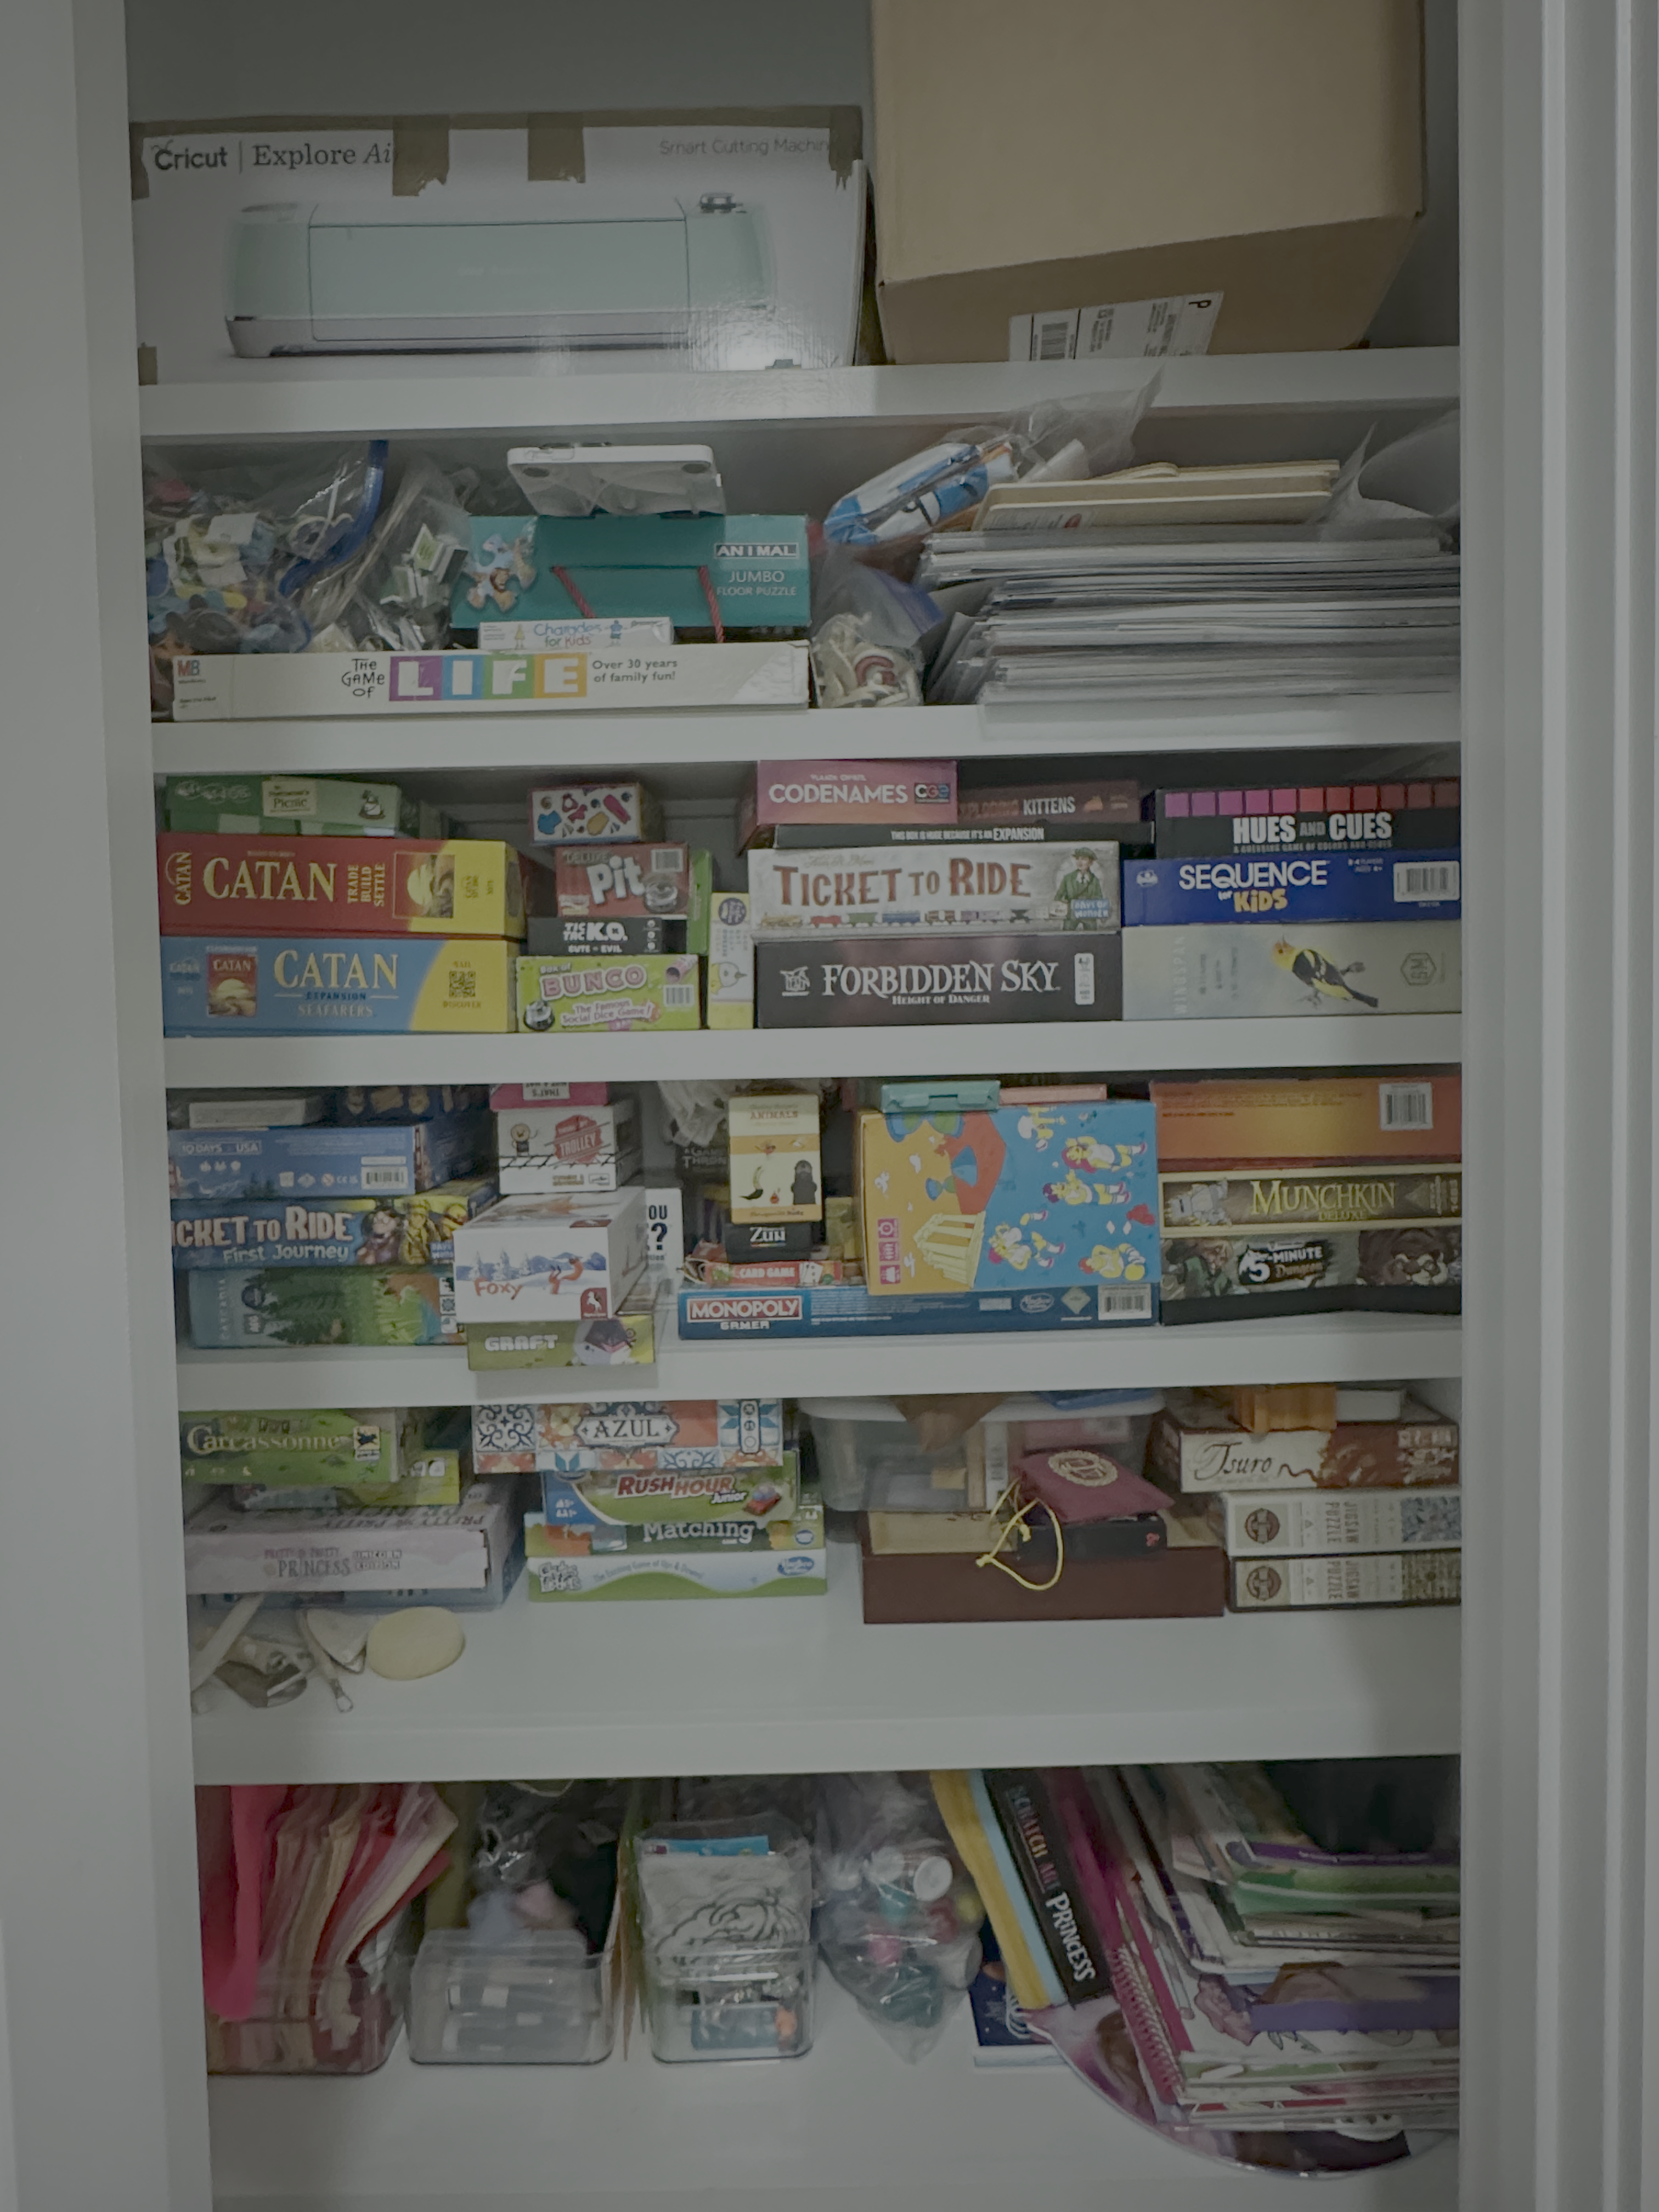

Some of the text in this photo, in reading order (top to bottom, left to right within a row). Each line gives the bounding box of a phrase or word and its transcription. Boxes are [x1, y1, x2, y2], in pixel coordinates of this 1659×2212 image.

[152, 139, 391, 170] Cricut Explore Ai
[660, 138, 830, 156] Smart Cutting Machin
[716, 545, 797, 556] ANIMAL
[729, 571, 785, 583] JUMBO
[716, 586, 797, 596] FLOOR PUZZLE
[534, 621, 601, 636] Charades
[545, 635, 592, 648] for Kids
[177, 659, 200, 676] MB
[592, 659, 678, 671] Over 30 years
[398, 658, 580, 697] LIFE
[594, 671, 675, 684] of family fun!
[769, 783, 909, 804] CODENAMES
[1023, 795, 1076, 816] KITTENS
[891, 830, 905, 840] THIS
[993, 827, 1044, 840] EXPANSION
[1233, 811, 1392, 844] HUES AND CUES
[174, 851, 192, 905] CATAN
[204, 856, 338, 902] CATAN
[347, 864, 359, 904] TRADE
[360, 865, 373, 903] BUILD
[374, 861, 386, 908] SETTLE
[772, 856, 1032, 906] TICKET TO RIDE
[1178, 860, 1328, 890] SEQUENCE
[1217, 890, 1233, 901] for
[563, 932, 585, 941] TAC
[565, 922, 585, 932] TIC
[586, 922, 629, 941] K.O.
[568, 944, 623, 953] CUTE EVIL
[212, 960, 252, 972] CATAN
[273, 949, 399, 990] CATAN
[1172, 936, 1186, 1015] WINGSPAN
[541, 964, 646, 1000] BUNCO
[821, 959, 1059, 998] FORBIDDEN SKY
[304, 991, 367, 1001] EXPANSION
[891, 994, 990, 1005] HEIGHT OF DANGER
[298, 1003, 374, 1018] SEAFARERS
[575, 1000, 636, 1015] The Famous
[562, 1012, 591, 1024] Social
[594, 1011, 614, 1020] Dice
[532, 1088, 560, 1097] THAT'S
[750, 1110, 798, 1120] ANIMALS
[195, 1143, 222, 1153] DAYS
[236, 1142, 258, 1153] USA
[560, 1132, 596, 1156] TROLLEY
[1250, 1180, 1396, 1216] MUNCHKIN
[648, 1205, 668, 1220] OU
[1318, 1210, 1367, 1222] DELUXE
[171, 1206, 354, 1247] ICKET TO RIDE
[223, 1244, 349, 1264] First Journey
[740, 1267, 795, 1279] CARD GAME
[691, 1299, 798, 1319] MONOPOLY
[720, 1321, 770, 1330] GAMER
[484, 1335, 558, 1352] GRAFT
[594, 1419, 660, 1438] AZUL
[187, 1425, 341, 1455] Carcassonne
[1194, 1442, 1272, 1481] Tsuro
[615, 1474, 735, 1499] RUSH HOUR
[710, 1490, 747, 1505] Junior
[1325, 1501, 1342, 1543] PUZZLE
[1344, 1500, 1359, 1543] JIGSAW
[642, 1521, 754, 1544] Matching
[278, 1558, 351, 1578] PRINCESS
[1327, 1560, 1343, 1600] PUZZLE
[1345, 1560, 1360, 1599] JIGSAW
[1008, 1786, 1049, 1859] SCRATCH
